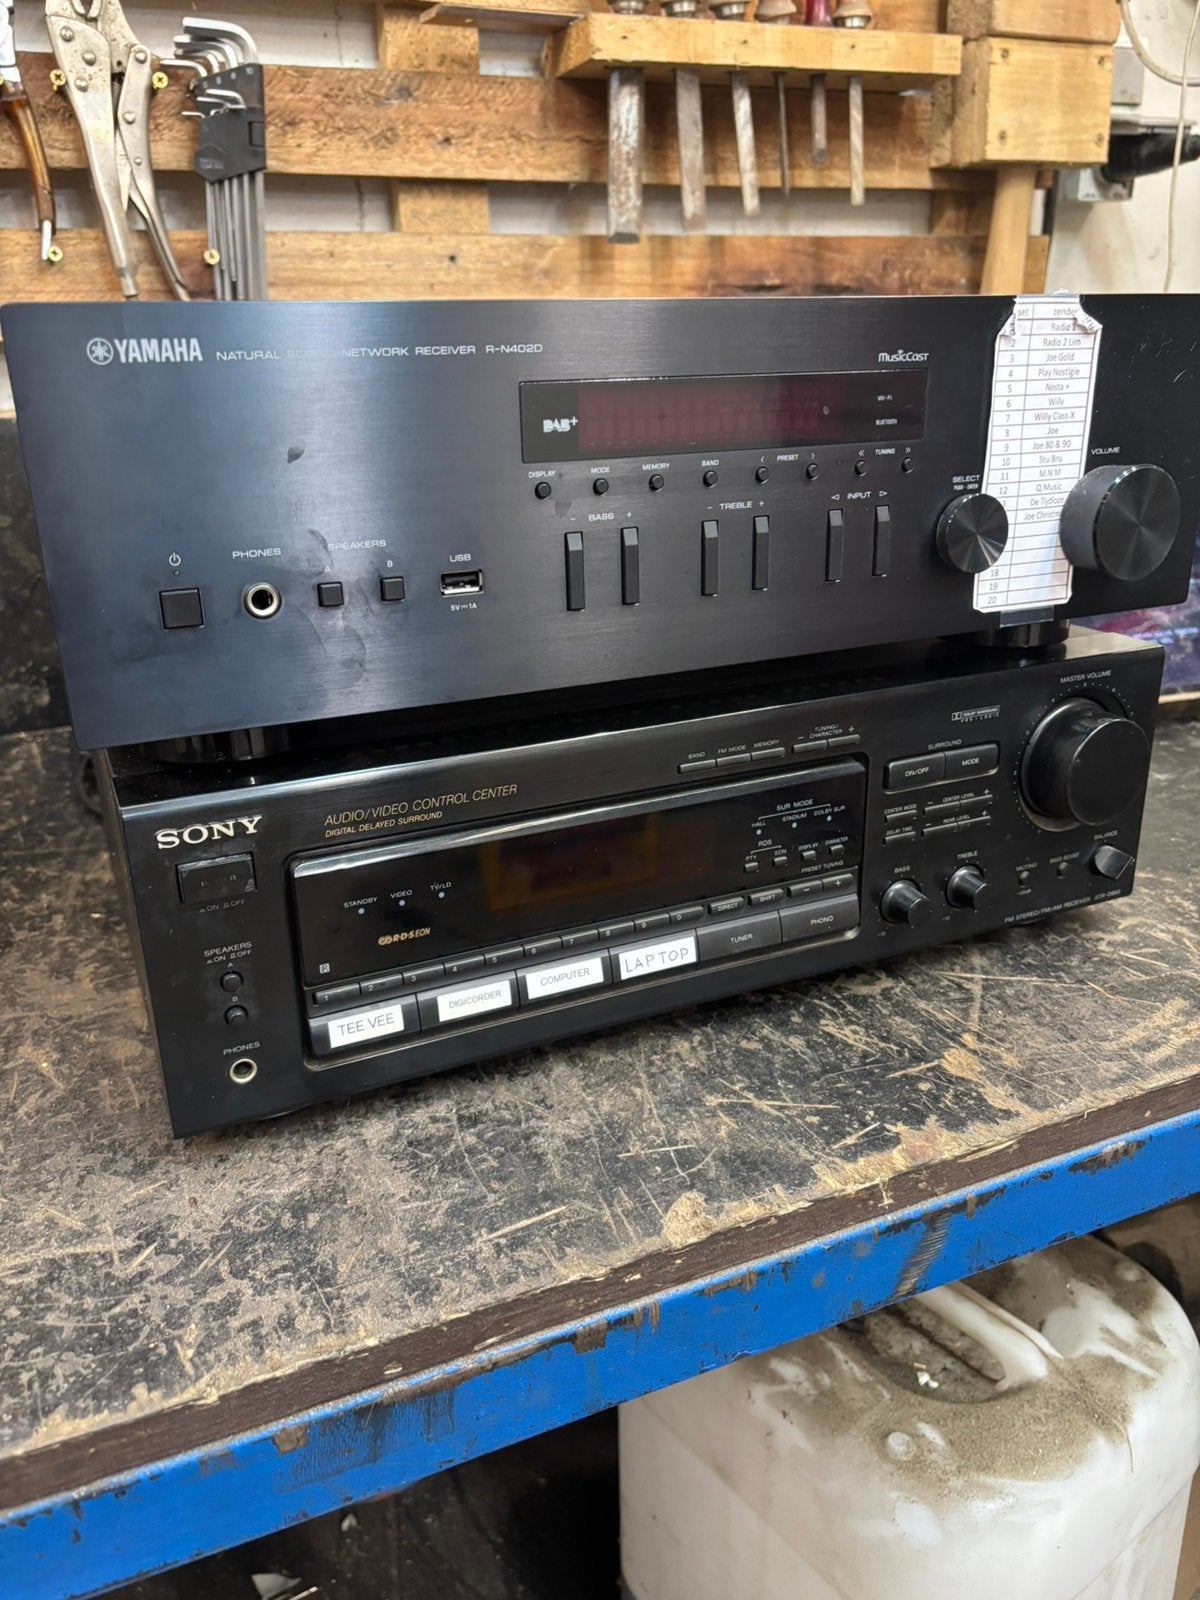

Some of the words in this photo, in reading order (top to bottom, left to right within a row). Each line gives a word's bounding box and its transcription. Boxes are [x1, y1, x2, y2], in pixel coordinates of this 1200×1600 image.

[1051, 322, 1071, 331] Radio
[1043, 338, 1061, 346] Radio
[1062, 338, 1068, 346] 2
[114, 338, 203, 363] YAMAHA
[341, 346, 409, 357] NETWORK
[415, 345, 476, 355] RECEIVER
[486, 344, 543, 354] R-N402D
[215, 350, 282, 361] NATURAL
[1009, 354, 1015, 363] 3
[1046, 354, 1057, 362] Joe
[1058, 352, 1075, 361] Gold
[1008, 370, 1013, 378] 4
[1038, 369, 1052, 377] Play
[1007, 384, 1012, 393] 5
[1045, 383, 1064, 391] Nosta
[1006, 400, 1011, 408] 6
[1048, 398, 1064, 407] Willy
[1034, 412, 1051, 421] Willy
[1052, 412, 1069, 420] Class
[1005, 429, 1010, 437] 8
[1047, 427, 1059, 435] Joe
[1004, 443, 1009, 452] 9
[1032, 442, 1045, 450] Joe
[1045, 441, 1054, 449] 80
[1061, 440, 1071, 448] 90
[1090, 446, 1120, 455] VOLUME
[776, 454, 799, 462] PRESET
[1002, 458, 1010, 466] 10
[1039, 456, 1049, 464] Stu
[1050, 455, 1062, 463] Bru
[642, 462, 670, 471] MEMORY
[701, 459, 719, 467] BAND
[528, 470, 556, 479] DISPLAY
[591, 466, 610, 474] MODE
[1047, 469, 1053, 477] N
[952, 474, 981, 483] SELECT
[1001, 472, 1009, 480] 11
[999, 486, 1008, 495] 12
[1035, 484, 1042, 492] Q
[1043, 482, 1062, 490] Music
[847, 491, 871, 499] INPUT
[719, 501, 752, 510] TREBLE
[1030, 498, 1039, 506] De
[588, 513, 614, 521] BASS
[1024, 512, 1036, 520] Joe
[327, 540, 387, 551] SPEAKERS
[232, 548, 282, 559] PHONES
[449, 553, 472, 562] USB
[324, 565, 331, 573] A
[990, 569, 999, 577] 18
[989, 582, 998, 590] 19
[987, 596, 997, 604] 20
[1060, 673, 1085, 683] MASTER
[1086, 669, 1112, 679] VOLUME
[809, 728, 843, 739] CHARACTER
[753, 739, 779, 748] MEMORY
[928, 739, 962, 750] SURROUND
[728, 744, 746, 753] MODE
[687, 751, 706, 760] BAND
[961, 757, 980, 766] MODE
[904, 766, 930, 777] ON/OFF
[324, 802, 408, 826] AUDIO/VIDEO
[412, 792, 470, 811] CONTROL
[472, 784, 518, 801] CENTER
[776, 803, 791, 811] SUR
[793, 799, 814, 808] MODE
[325, 826, 356, 838] DIGITAL
[359, 819, 396, 832] DELAYED
[397, 811, 443, 825] SURROUND
[155, 815, 262, 849] SONY
[1094, 830, 1118, 840] BALANCE
[798, 842, 819, 851] DISPLAY
[957, 850, 979, 859] TREBLE
[894, 865, 911, 874] BASS
[390, 889, 413, 899] VIDEO
[760, 894, 776, 902] SHIFT
[343, 896, 378, 909] STANDBY
[718, 902, 738, 911] DIRECT
[1064, 896, 1092, 908] RECEIVER
[810, 915, 834, 925] PHONO
[730, 933, 753, 943] TUNER
[203, 941, 252, 957] SPEAKERS
[237, 949, 252, 958] OFF
[213, 955, 226, 963] ON
[452, 965, 458, 973] 4
[540, 967, 590, 986] COMPUTER
[368, 984, 374, 992] 2
[448, 989, 501, 1009] DIGICORDER
[338, 1020, 365, 1036] TEE
[367, 1012, 395, 1029] VEE
[223, 1041, 261, 1055] PHONES
